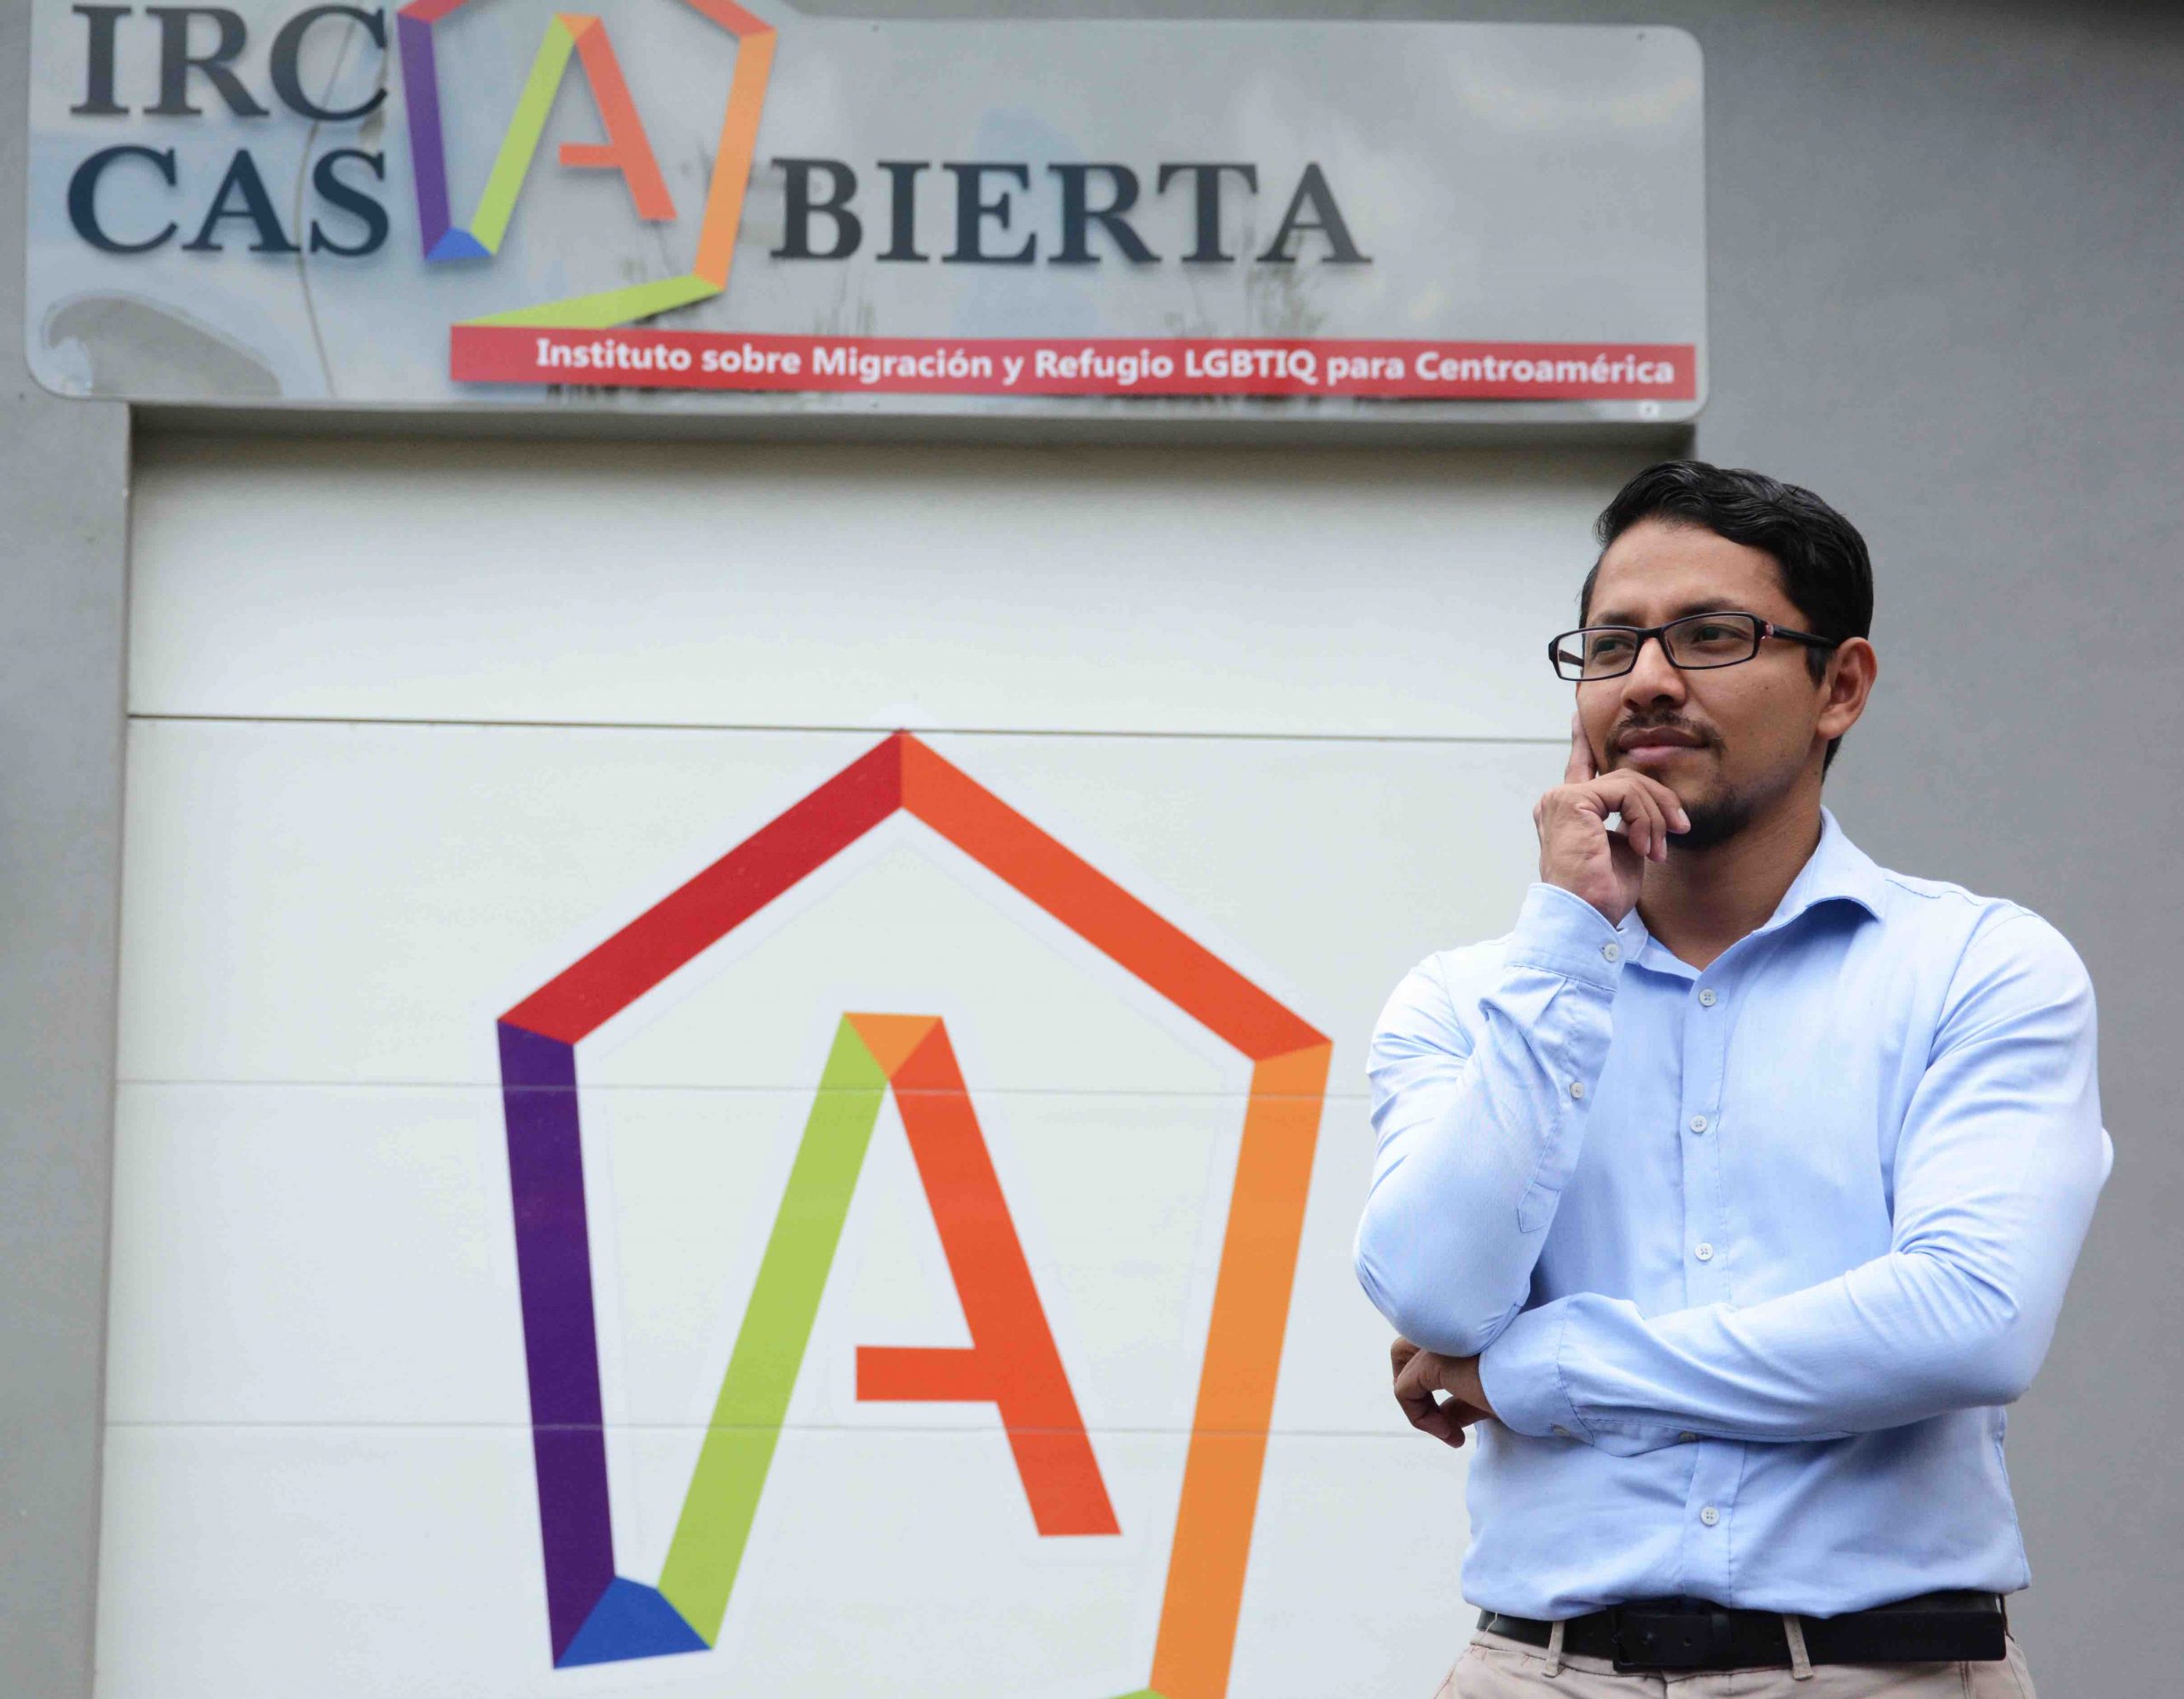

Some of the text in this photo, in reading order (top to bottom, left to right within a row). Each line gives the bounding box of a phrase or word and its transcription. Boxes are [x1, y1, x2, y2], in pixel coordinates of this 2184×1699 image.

[536, 338, 1675, 386] Instituto sobre Migración y Refugio LGBTIQ para Centroamérica
